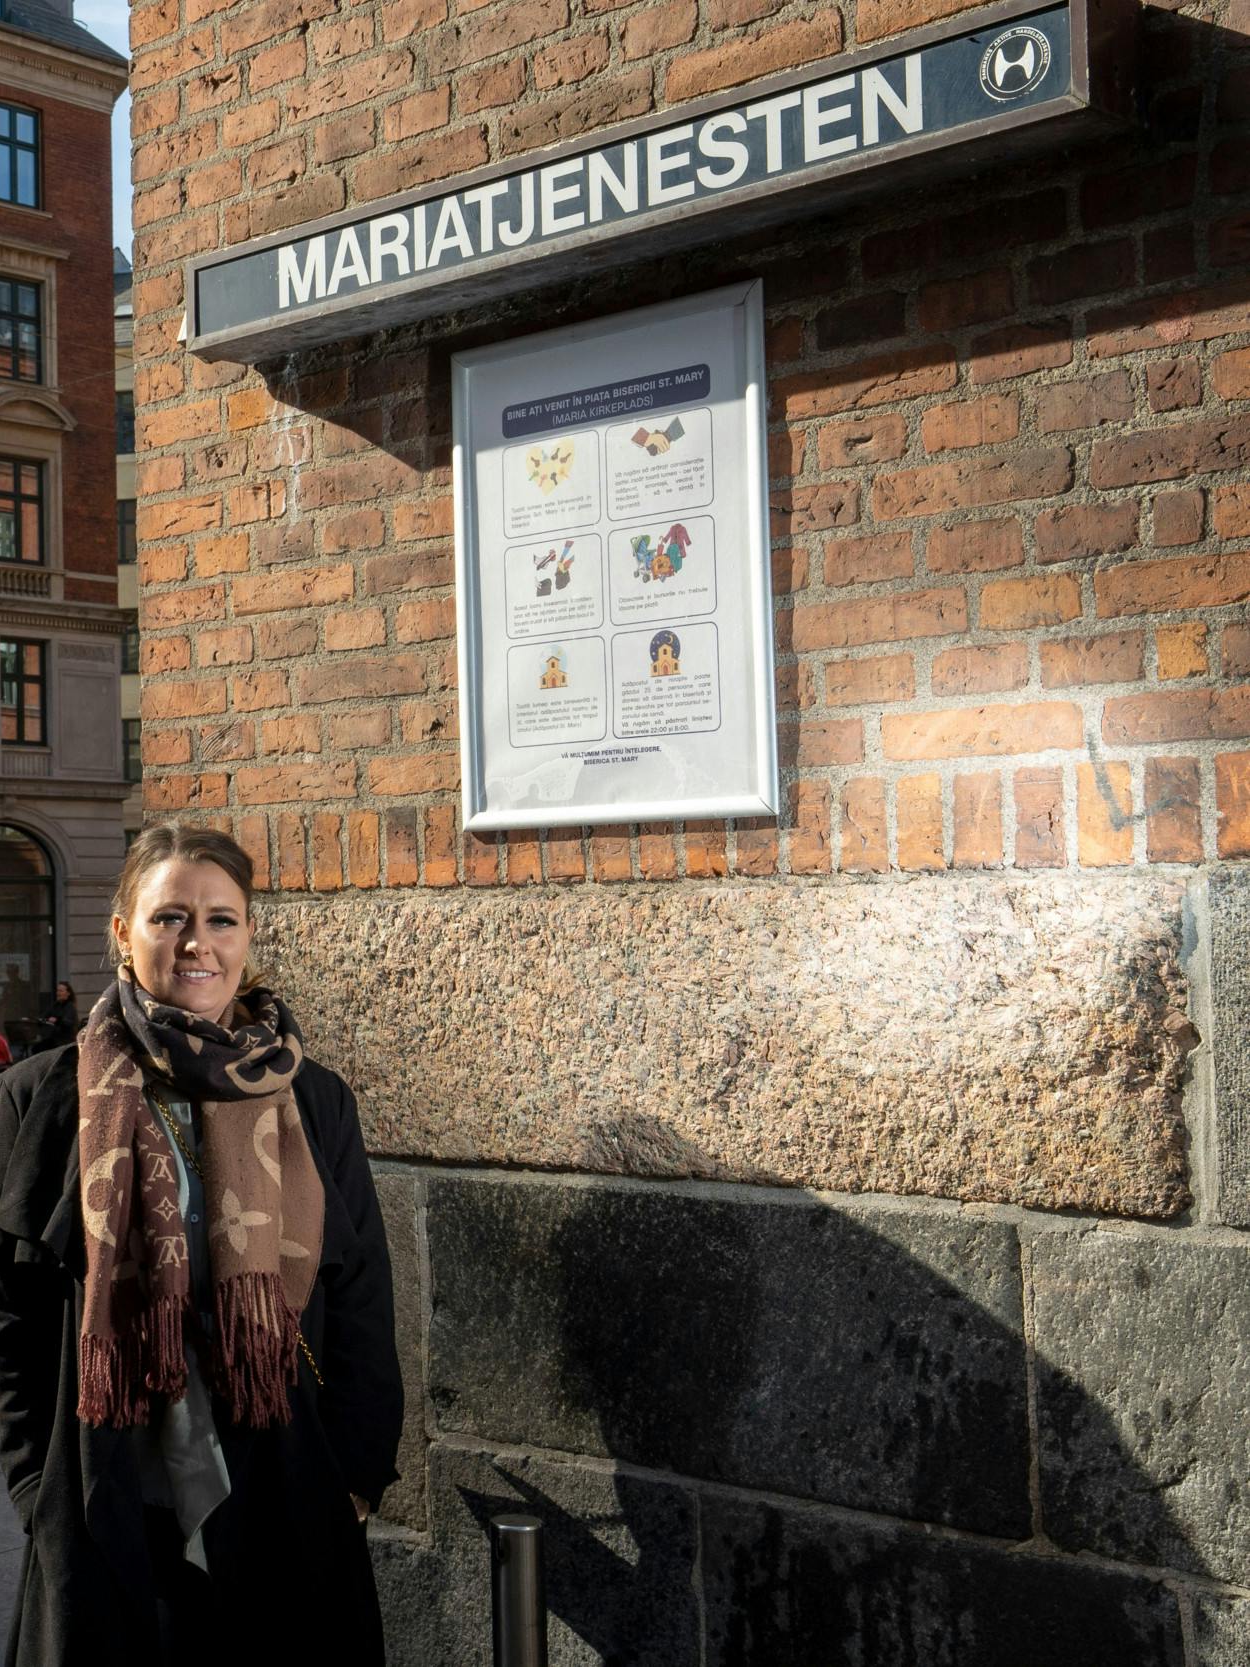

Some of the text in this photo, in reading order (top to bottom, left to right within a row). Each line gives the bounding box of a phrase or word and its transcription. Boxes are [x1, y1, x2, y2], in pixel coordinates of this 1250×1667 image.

[277, 53, 923, 310] MARIATJENESTEN
[507, 369, 704, 420] BINE AȚI VENIT ÎN PIAȚA BISERICII ST. MARY
[552, 395, 654, 426] (MARIA KIRKEPLADS)
[584, 757, 609, 765] BISERICA
